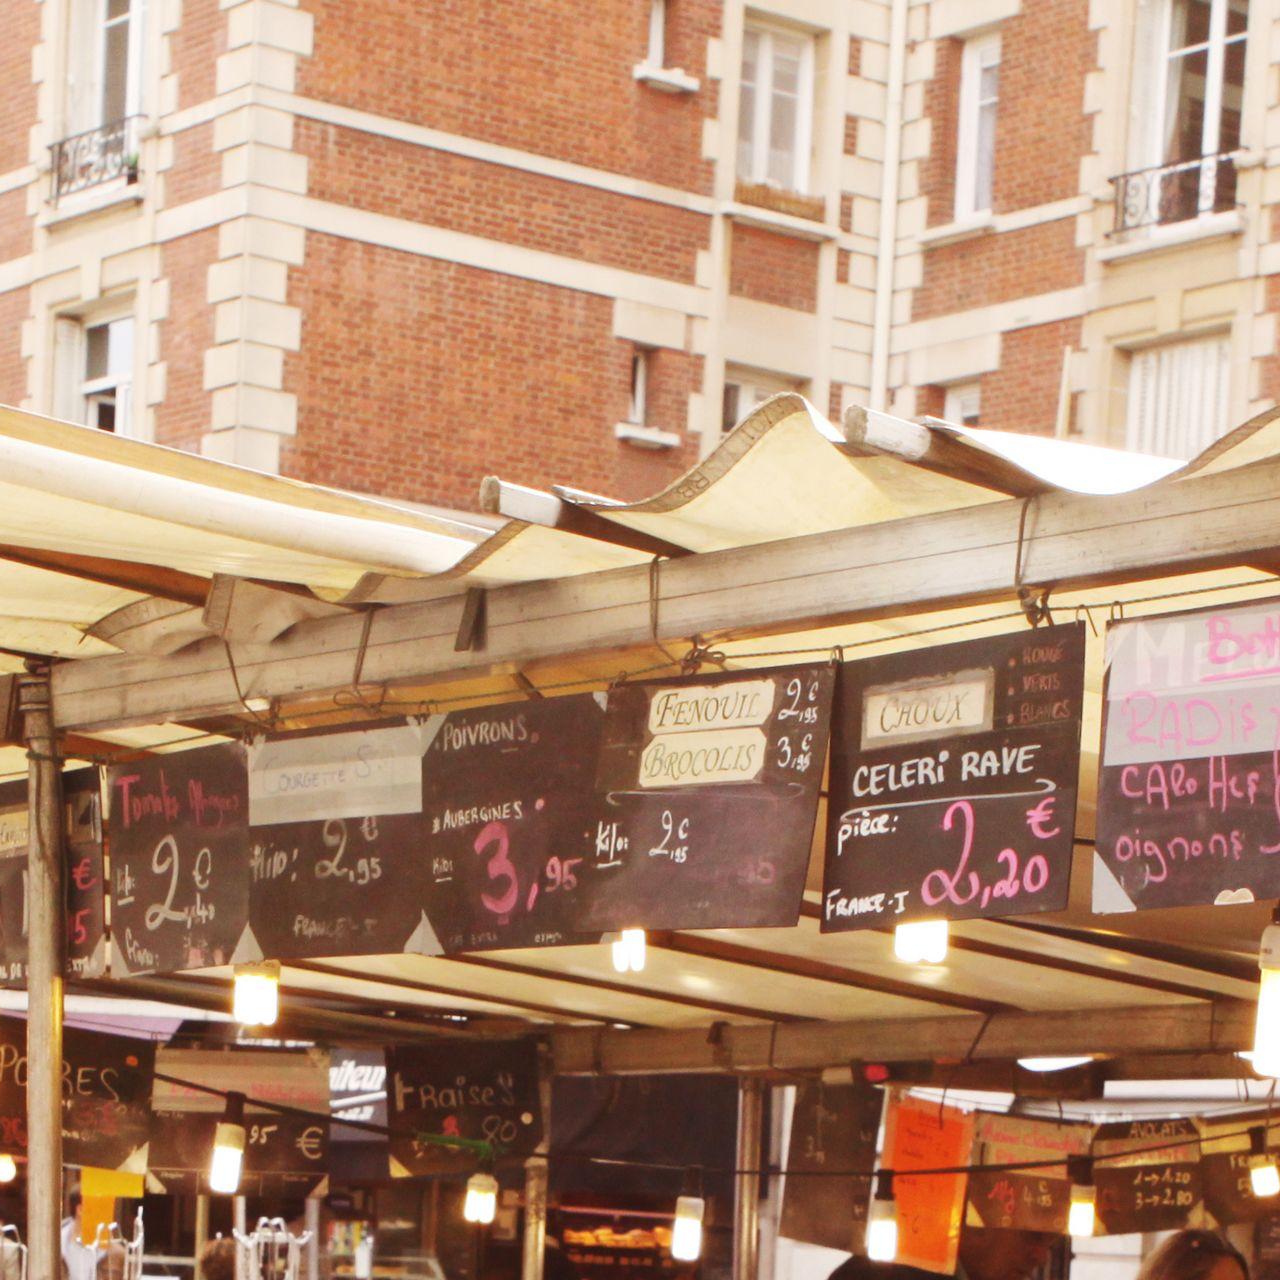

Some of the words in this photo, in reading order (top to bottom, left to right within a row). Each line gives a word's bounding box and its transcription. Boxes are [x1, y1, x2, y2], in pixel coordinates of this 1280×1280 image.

[656, 690, 762, 727] FENOUIL
[880, 691, 970, 733] CHOUX
[644, 743, 757, 781] BROCOLIS
[961, 745, 1042, 782] RAVE
